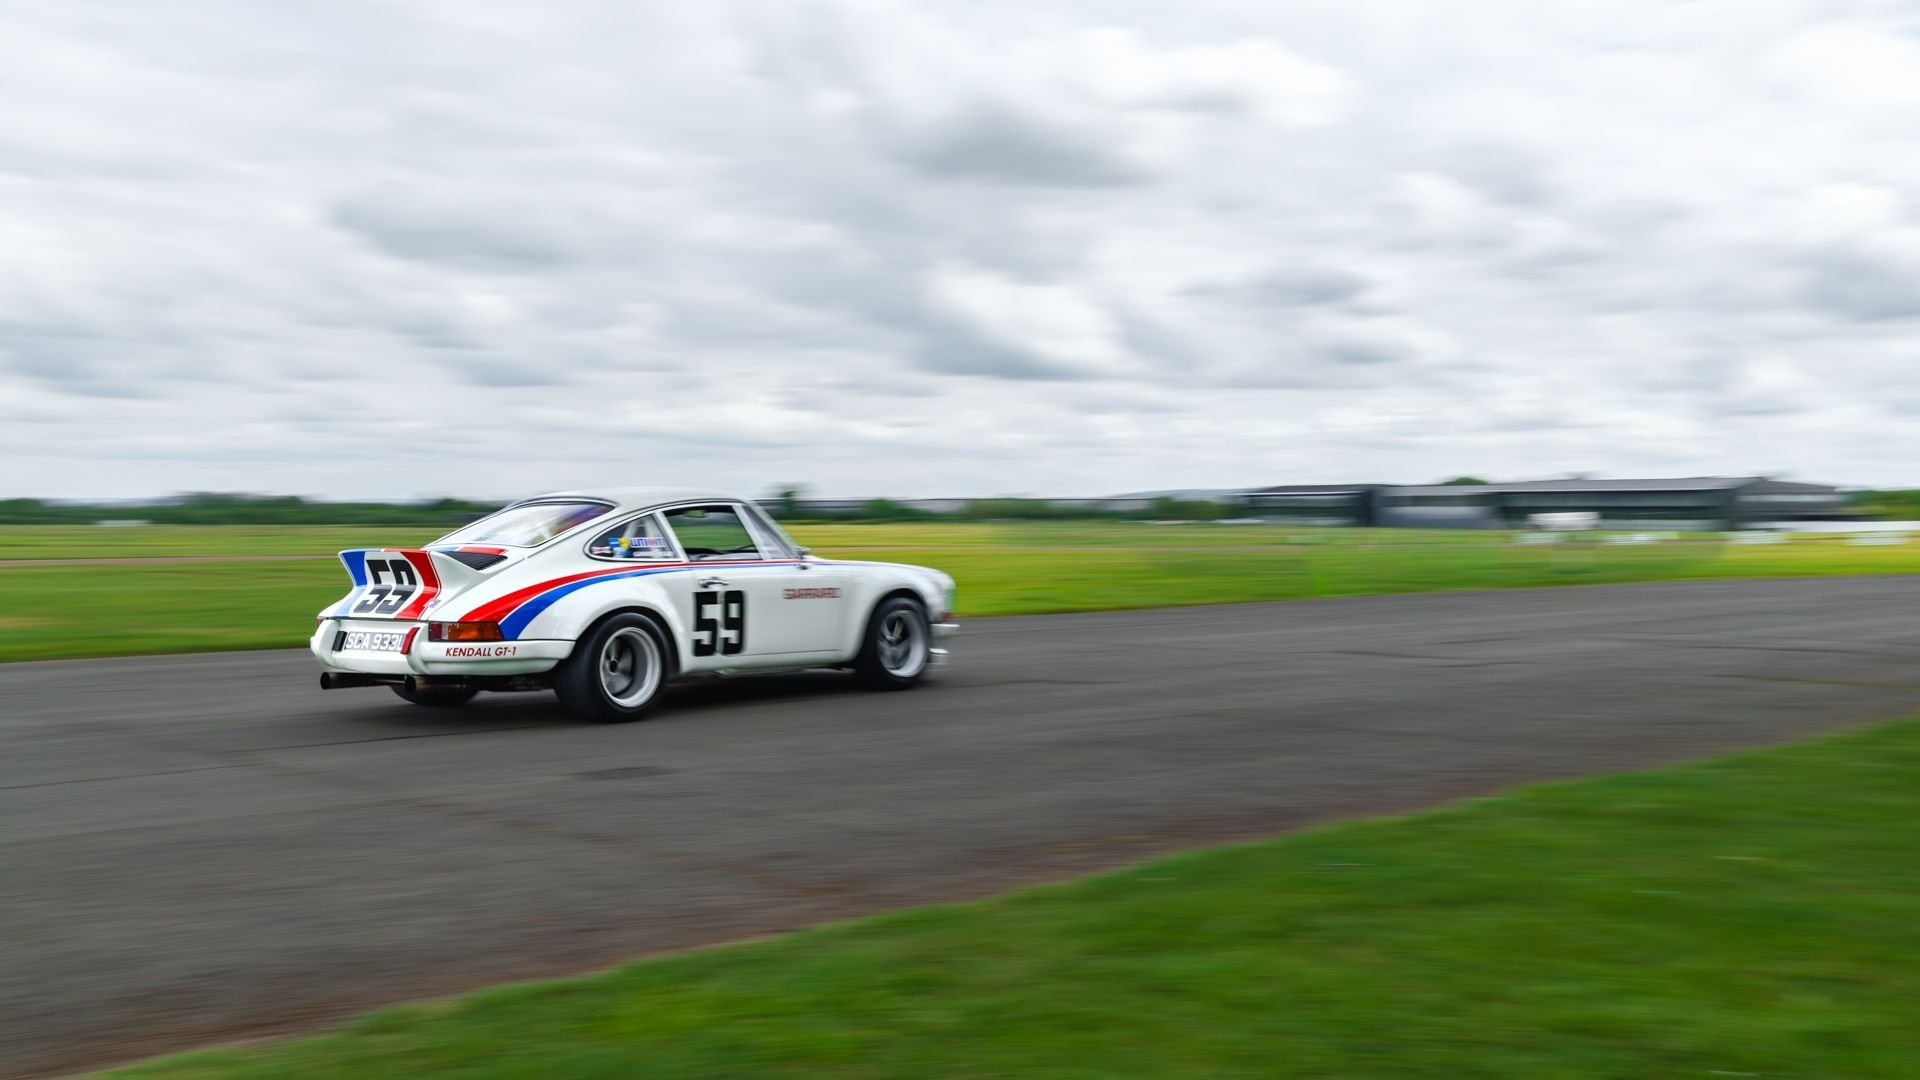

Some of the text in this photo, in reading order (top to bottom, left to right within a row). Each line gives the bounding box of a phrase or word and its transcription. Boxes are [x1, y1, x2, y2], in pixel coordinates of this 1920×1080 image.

[353, 560, 417, 614] 59
[694, 590, 743, 656] 59
[346, 633, 370, 649] SCA
[445, 647, 517, 657] KENDALL GT-1
